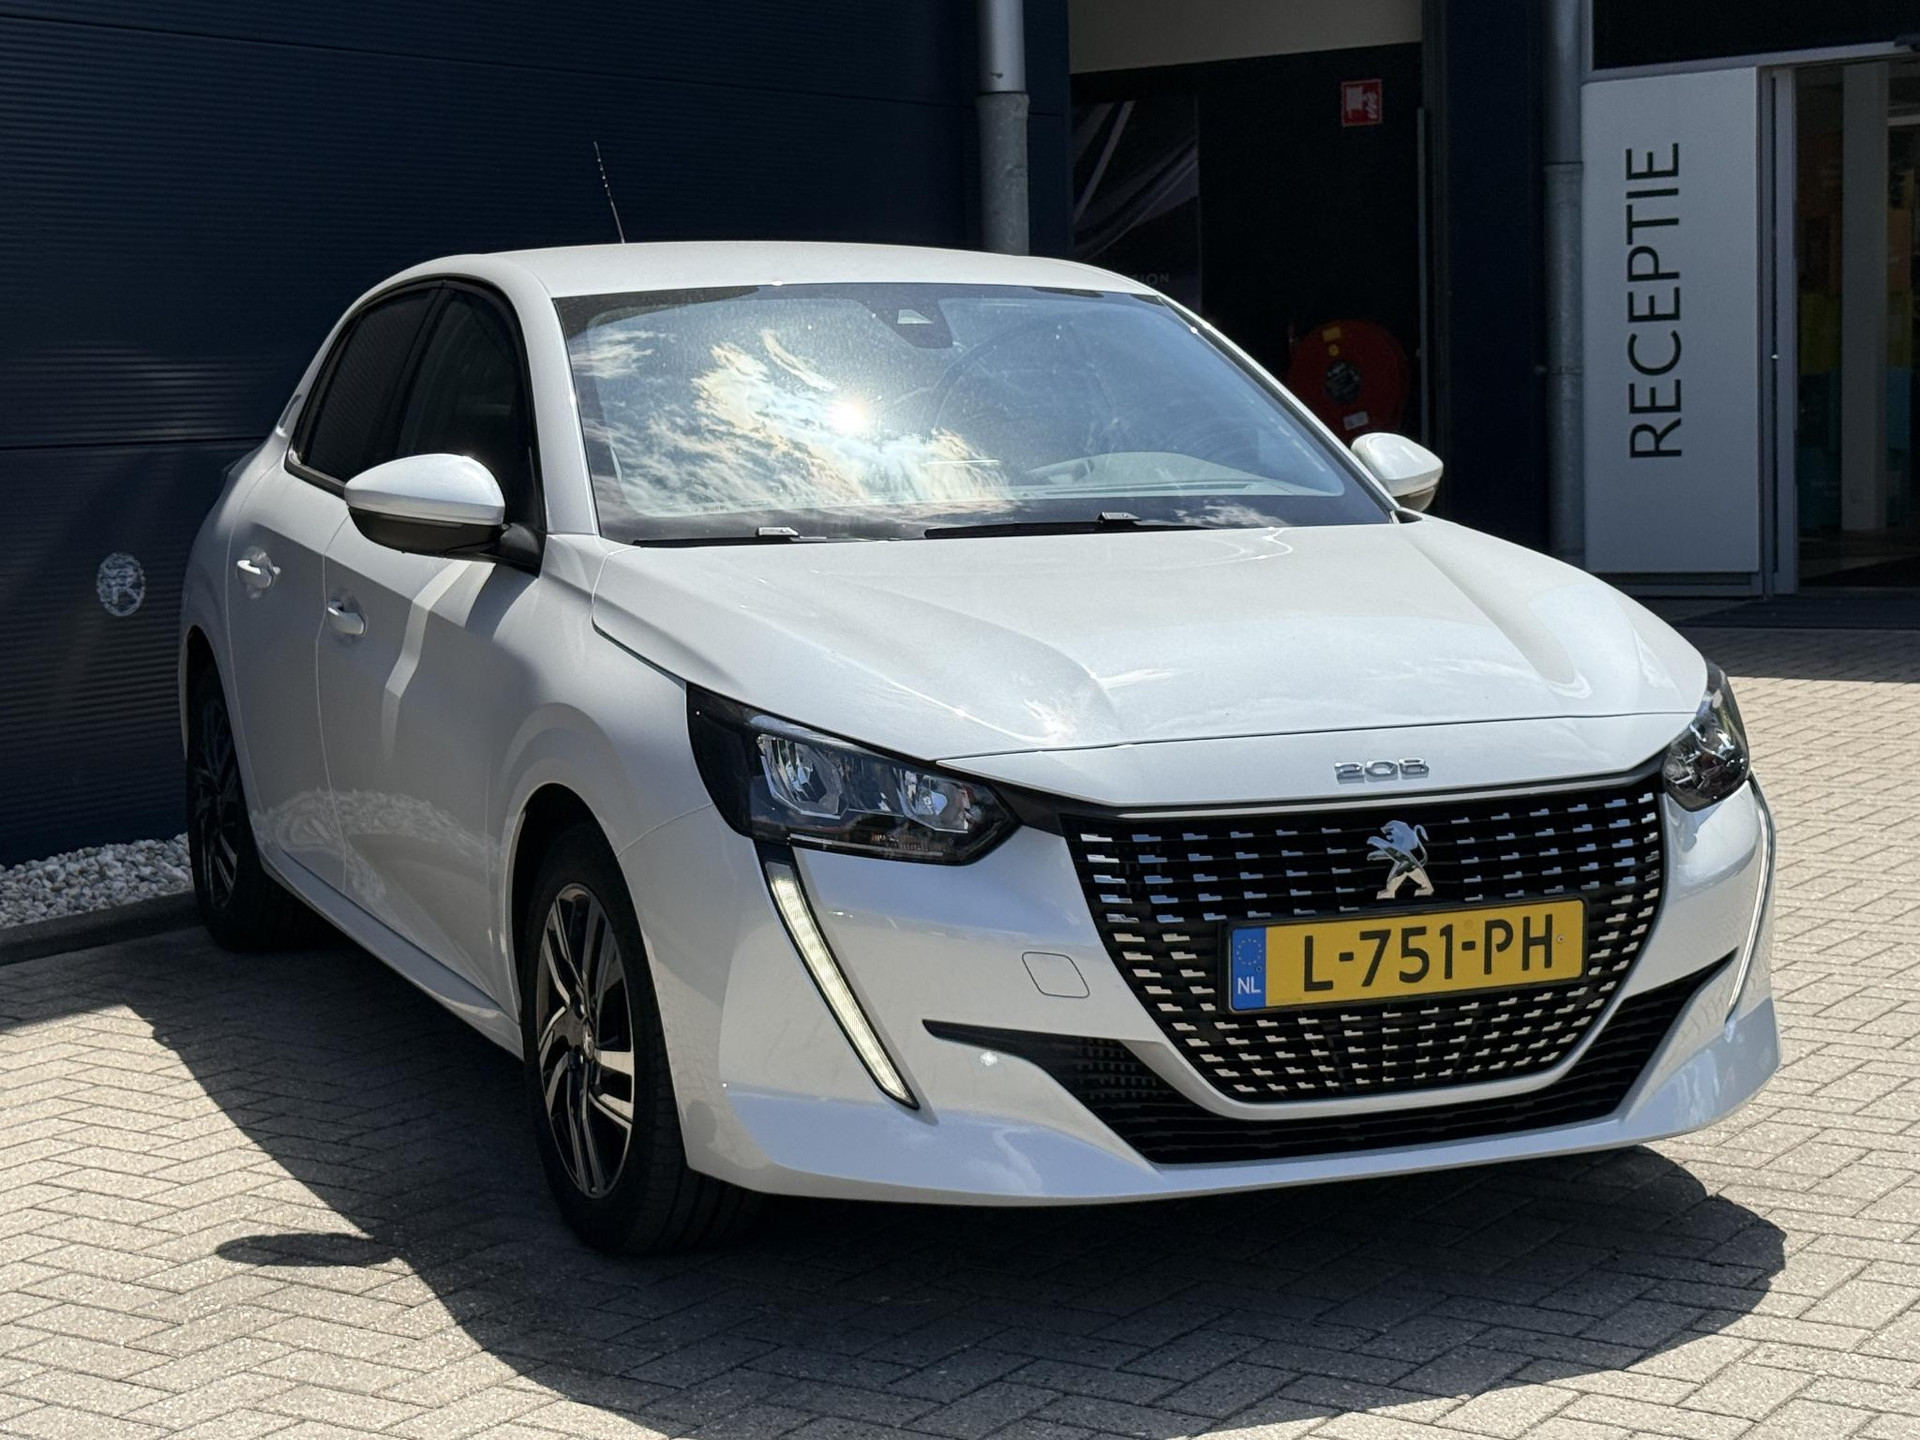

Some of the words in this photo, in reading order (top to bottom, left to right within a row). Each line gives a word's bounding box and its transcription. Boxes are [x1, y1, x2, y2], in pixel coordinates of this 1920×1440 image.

[1626, 142, 1682, 458] RECEPTIE
[1334, 758, 1430, 785] 208
[1303, 913, 1553, 992] L-751-PH
[1237, 977, 1261, 995] NL
